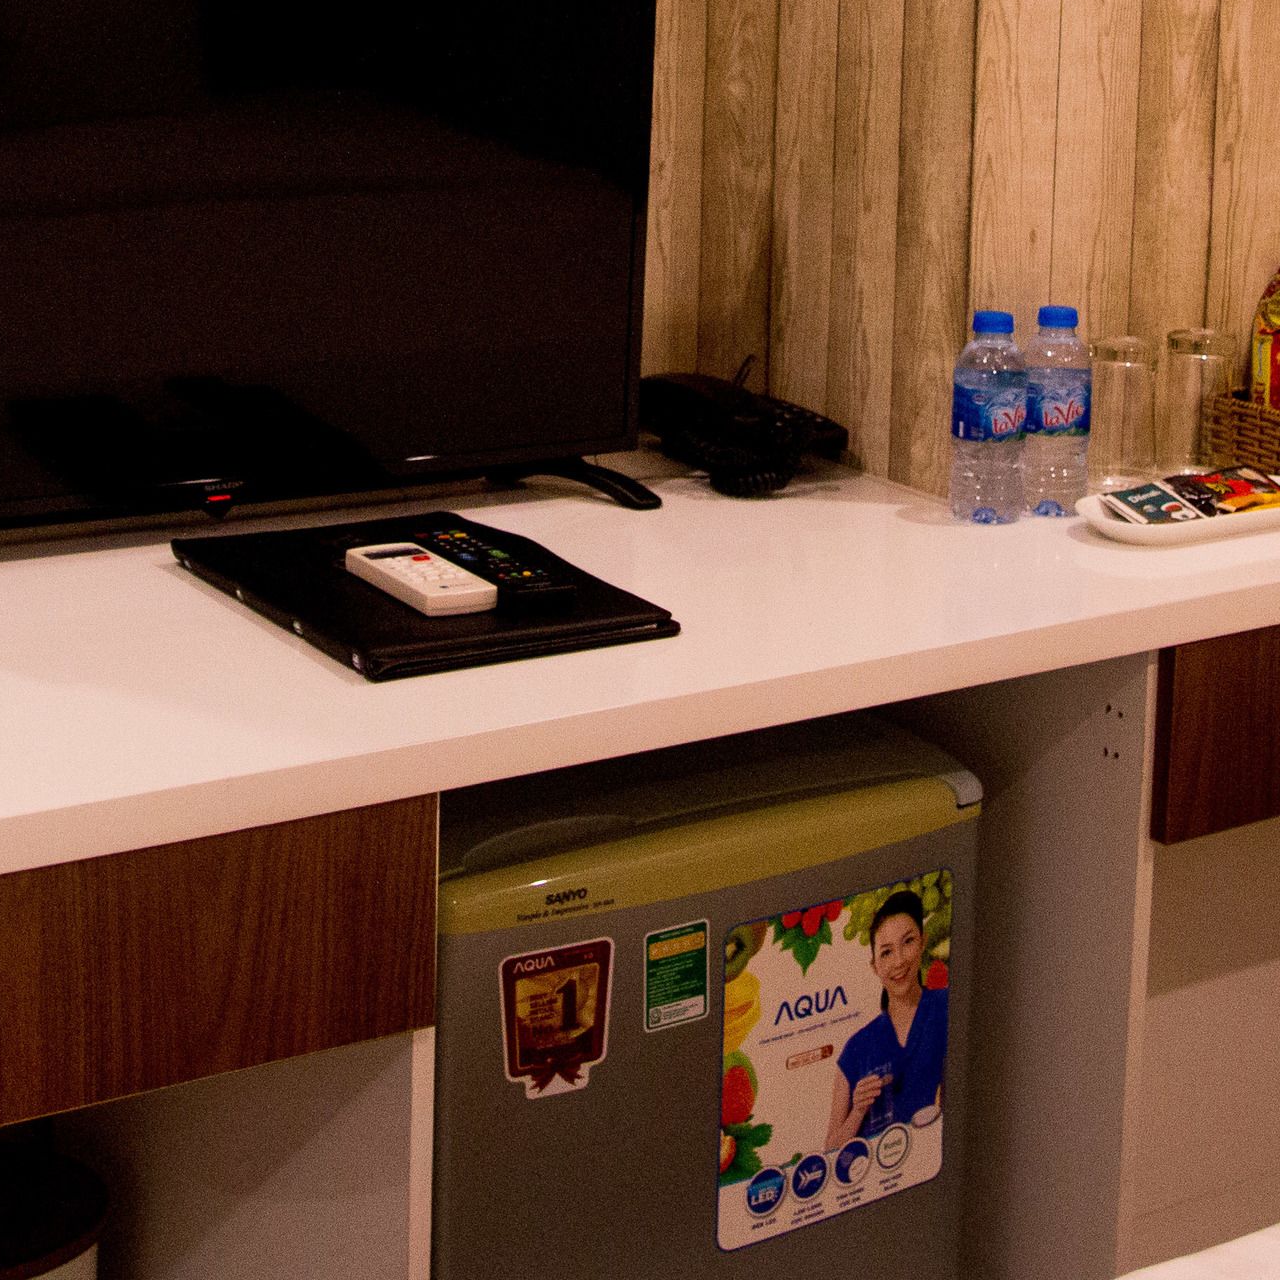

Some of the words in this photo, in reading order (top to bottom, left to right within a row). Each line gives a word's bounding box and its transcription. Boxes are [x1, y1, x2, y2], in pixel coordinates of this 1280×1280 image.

[545, 887, 588, 906] SANYO
[513, 955, 556, 975] AQUA
[773, 985, 848, 1026] AQUA
